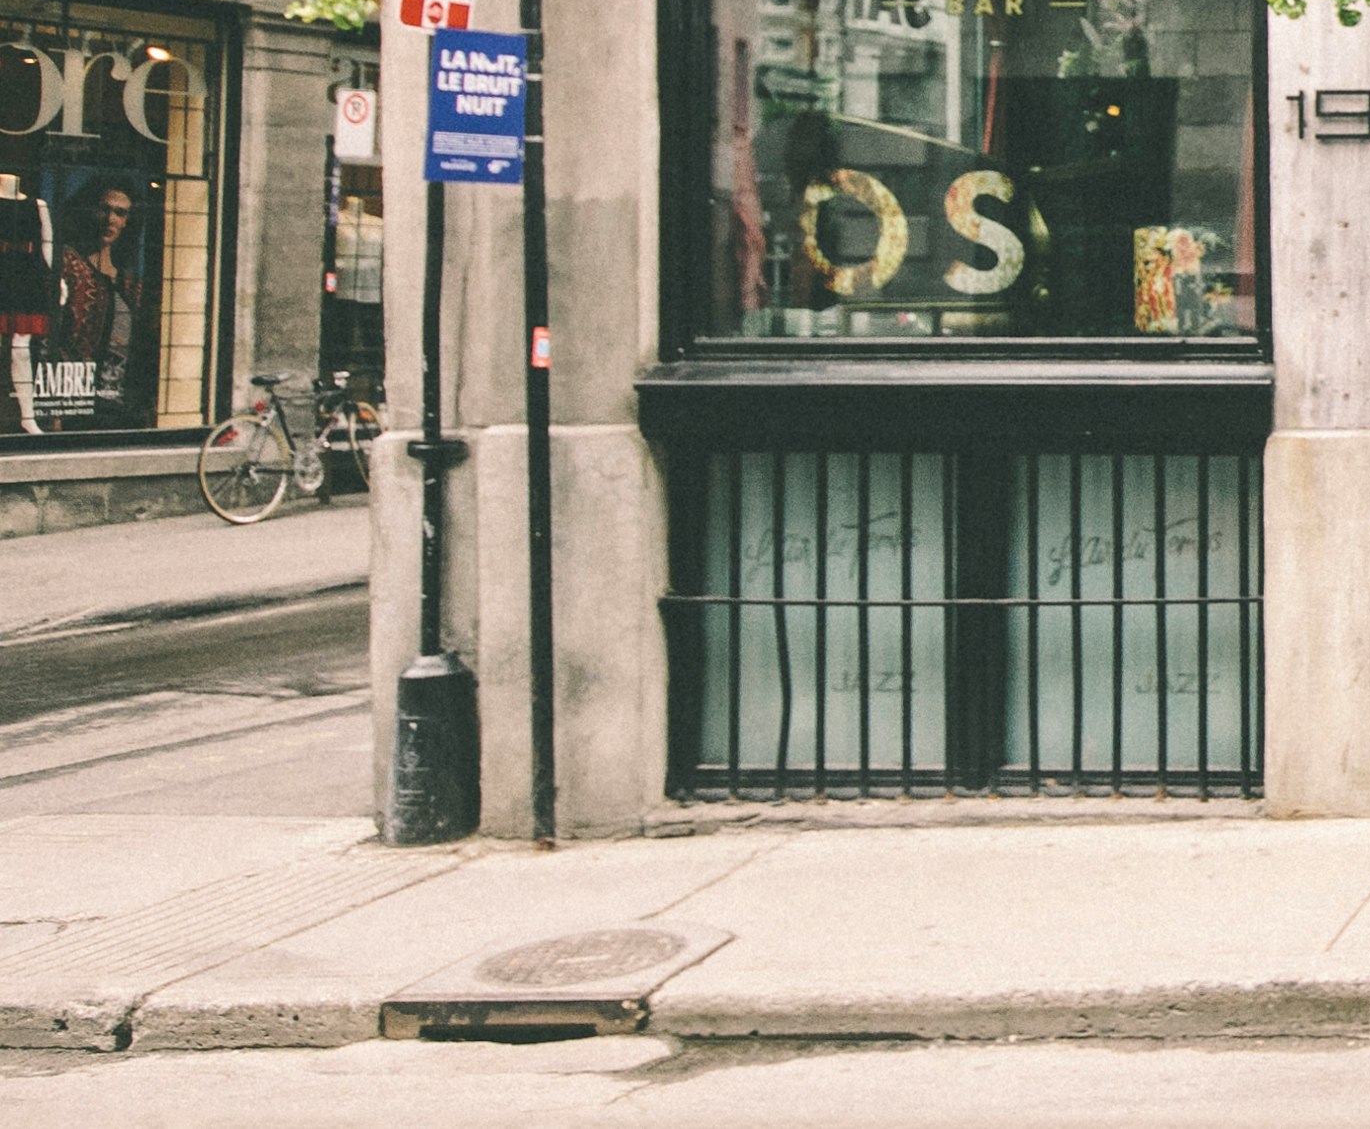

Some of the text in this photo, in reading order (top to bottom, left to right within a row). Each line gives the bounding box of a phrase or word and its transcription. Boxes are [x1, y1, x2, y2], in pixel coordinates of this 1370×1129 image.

[440, 49, 468, 70] LA
[437, 71, 523, 97] LE BRUIT
[456, 95, 508, 117] NUIT
[33, 361, 98, 398] AMBRE
